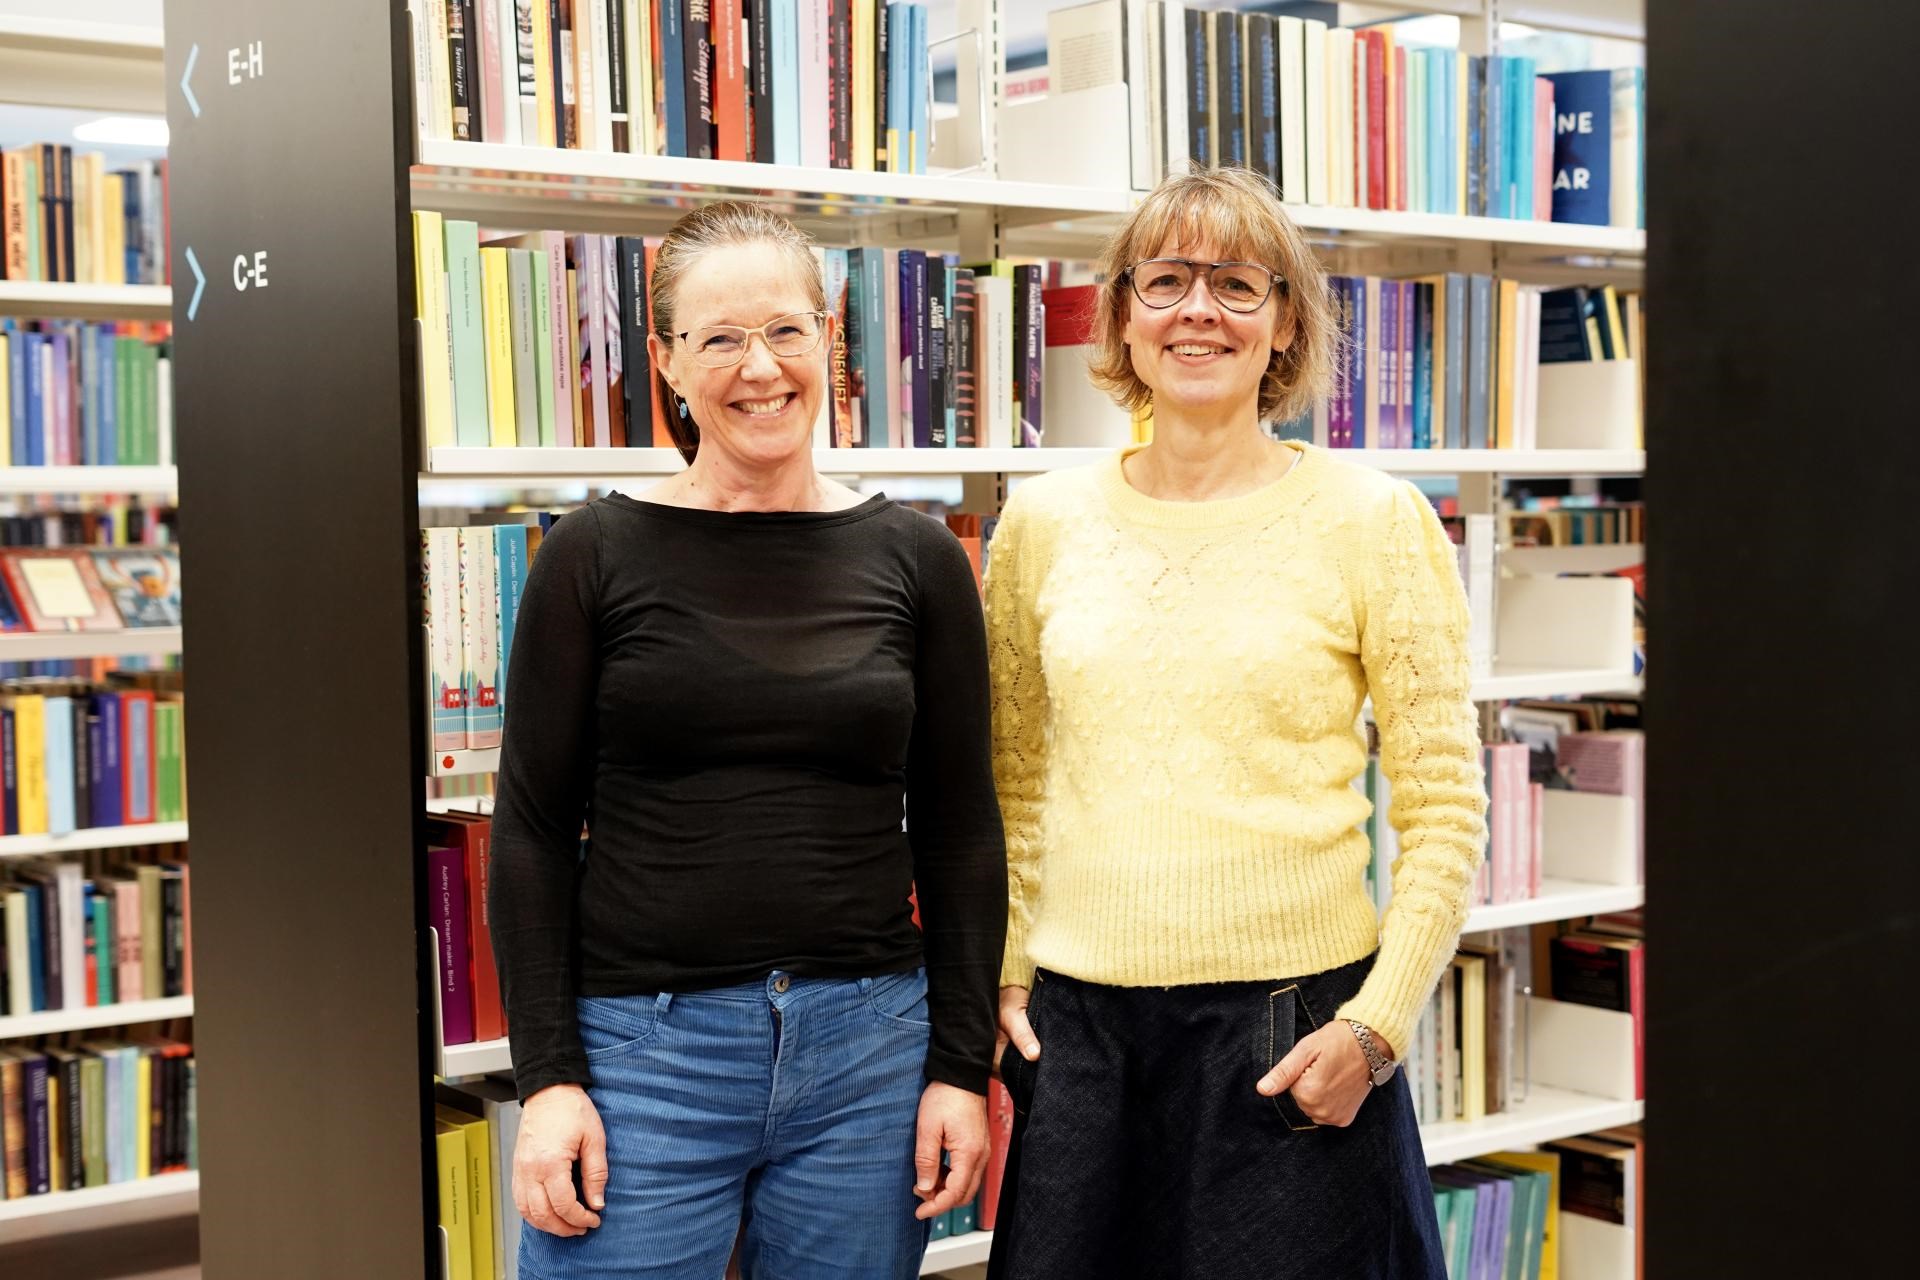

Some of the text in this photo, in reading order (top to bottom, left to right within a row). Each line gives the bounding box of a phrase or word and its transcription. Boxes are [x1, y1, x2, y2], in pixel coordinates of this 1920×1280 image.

[228, 41, 263, 85] E-H
[454, 80, 464, 97] spor
[233, 251, 268, 291] C-E
[633, 269, 641, 295] Bødker:
[634, 296, 643, 326] Vildskud
[930, 297, 938, 329] CAMERON
[936, 305, 944, 329] CLAIRE
[1028, 282, 1036, 358] ITALIENSKE NÆTTER
[916, 328, 924, 353] perfekte
[557, 336, 566, 372] fantastiske
[833, 322, 848, 404] SCENESKIFT
[557, 373, 566, 389] rejse
[510, 555, 518, 577] Caplin
[441, 865, 449, 891] Audrey
[444, 919, 452, 943] Dream
[446, 944, 454, 968] maker.
[447, 969, 455, 986] Bind
